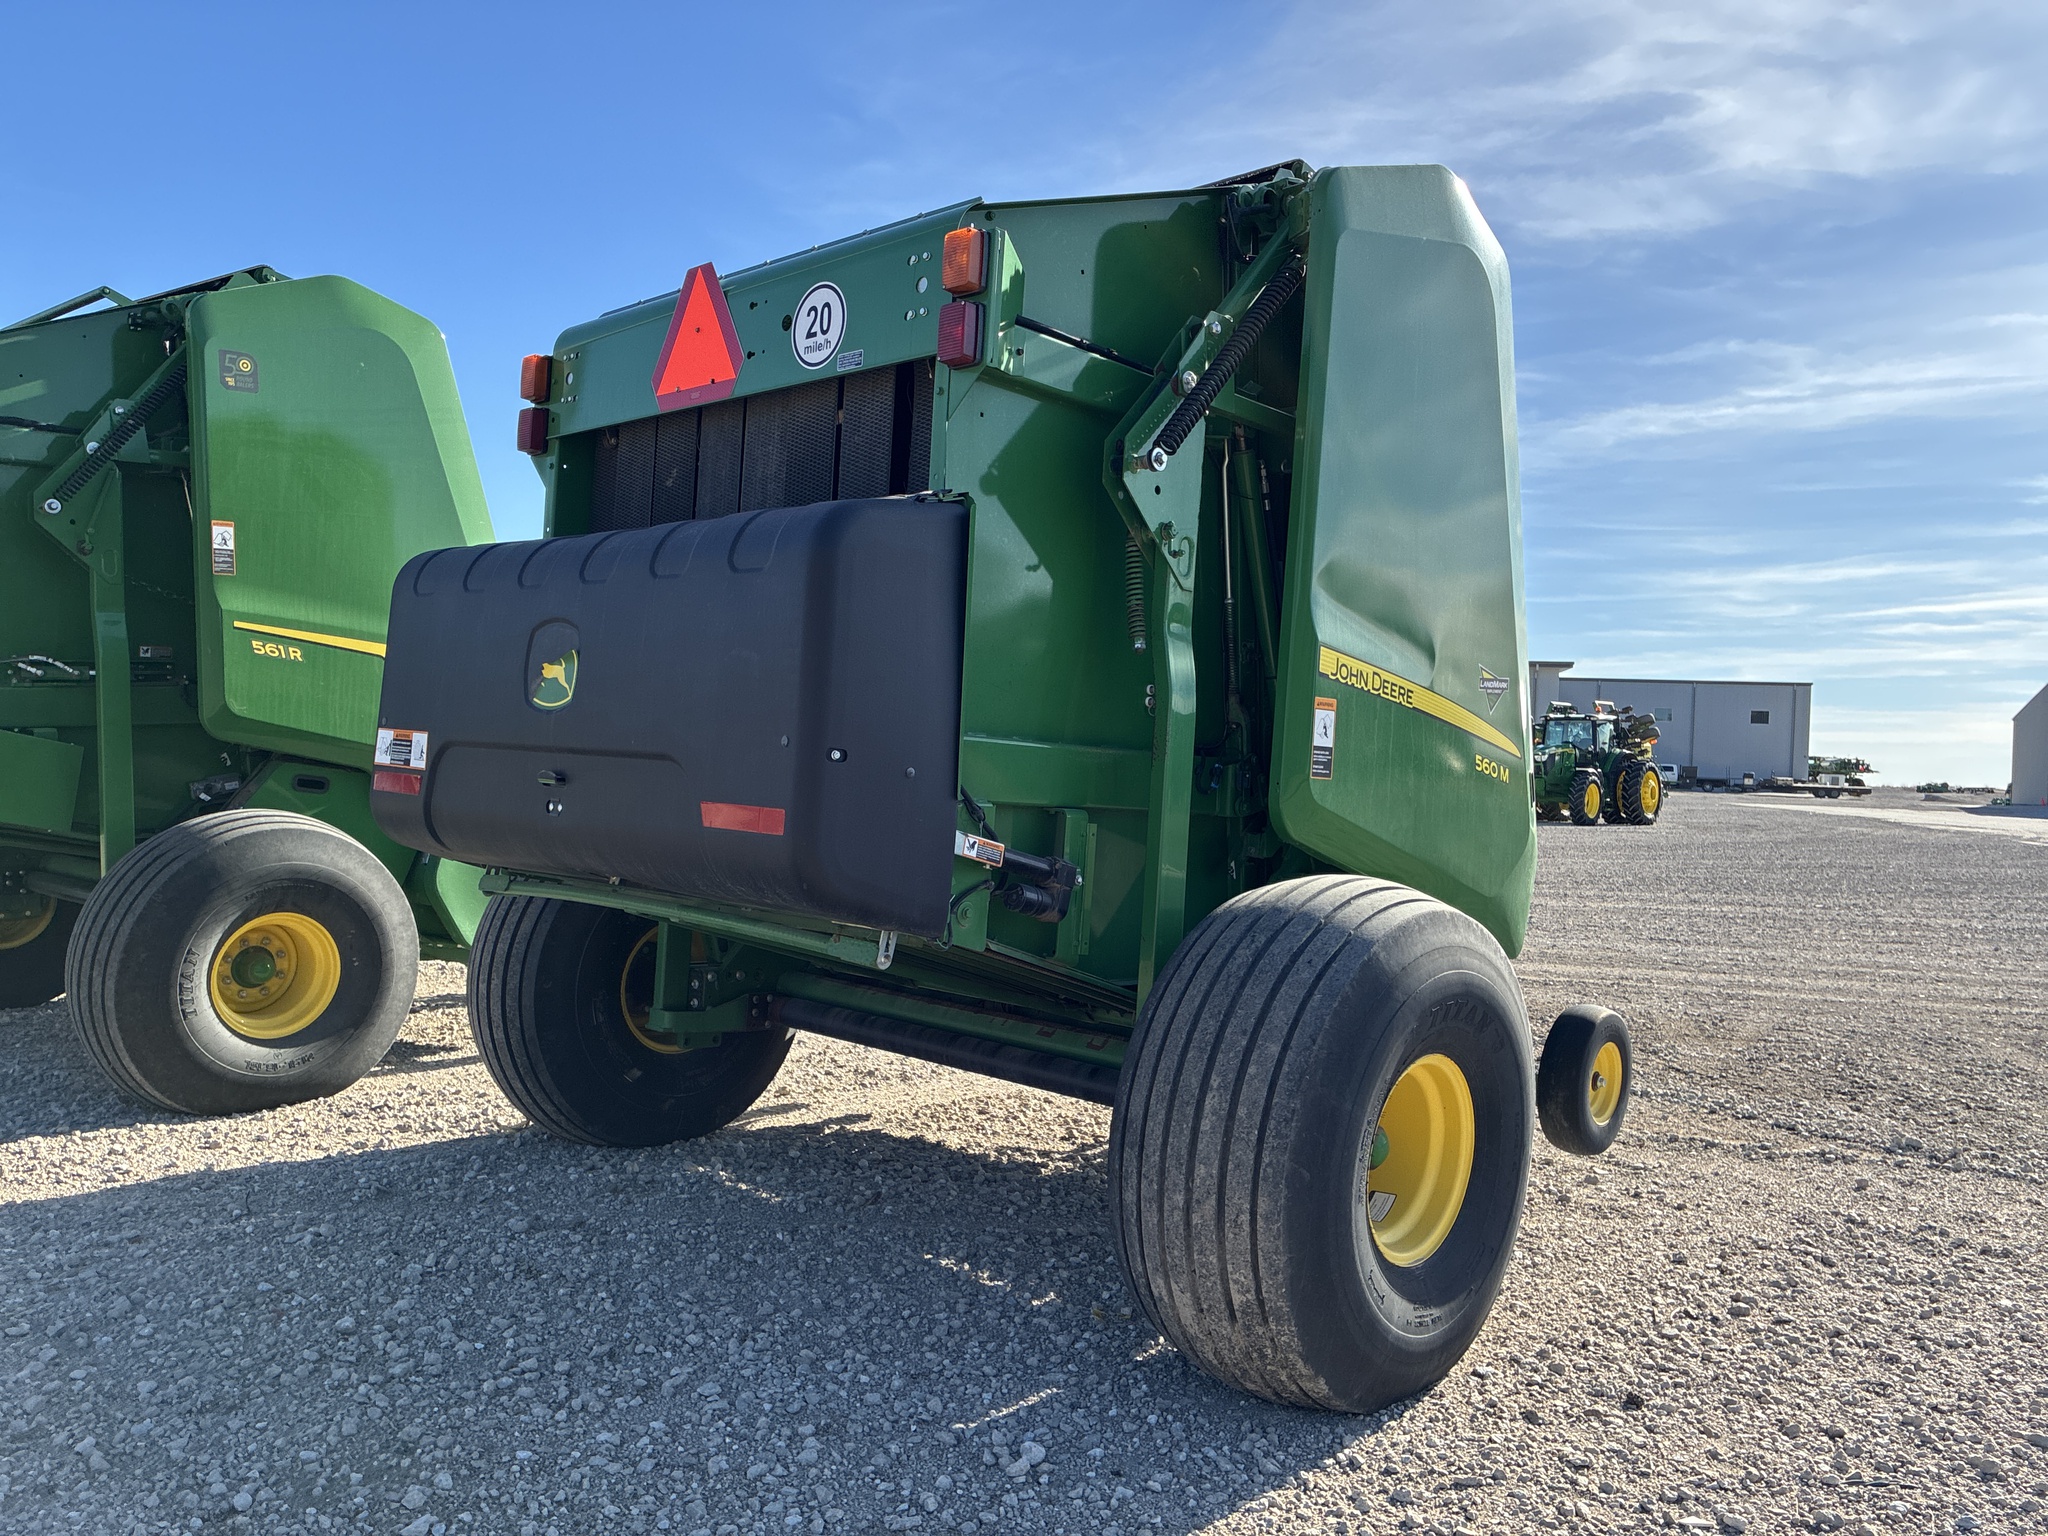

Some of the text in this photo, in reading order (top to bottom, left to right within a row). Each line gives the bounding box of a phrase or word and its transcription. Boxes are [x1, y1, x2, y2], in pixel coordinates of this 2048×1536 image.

[804, 301, 832, 340] 20
[803, 339, 832, 357] mile/h
[1329, 656, 1415, 706] JOHN DEERE
[1474, 753, 1510, 784] 560 M
